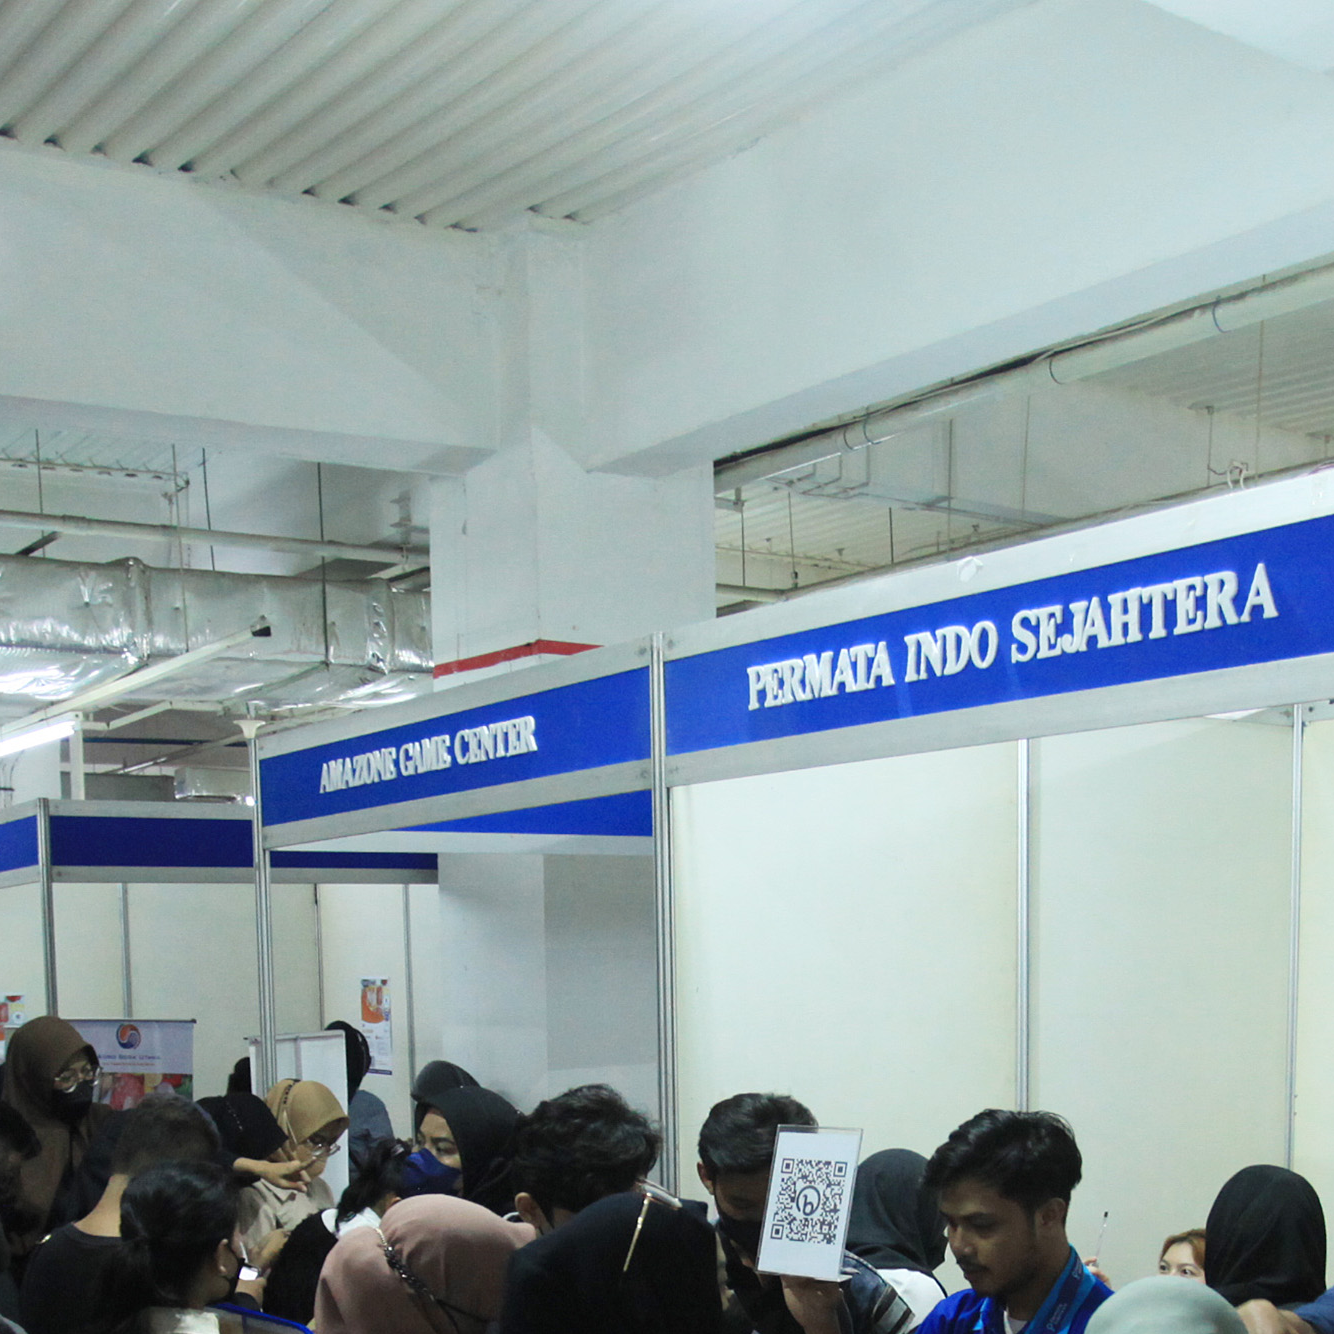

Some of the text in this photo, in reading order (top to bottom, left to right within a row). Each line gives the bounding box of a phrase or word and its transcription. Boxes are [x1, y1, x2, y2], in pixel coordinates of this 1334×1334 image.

[747, 562, 1280, 711] PERMATA INDO SEJAHTERA
[319, 715, 538, 793] AMAZONE GAME CENTER
